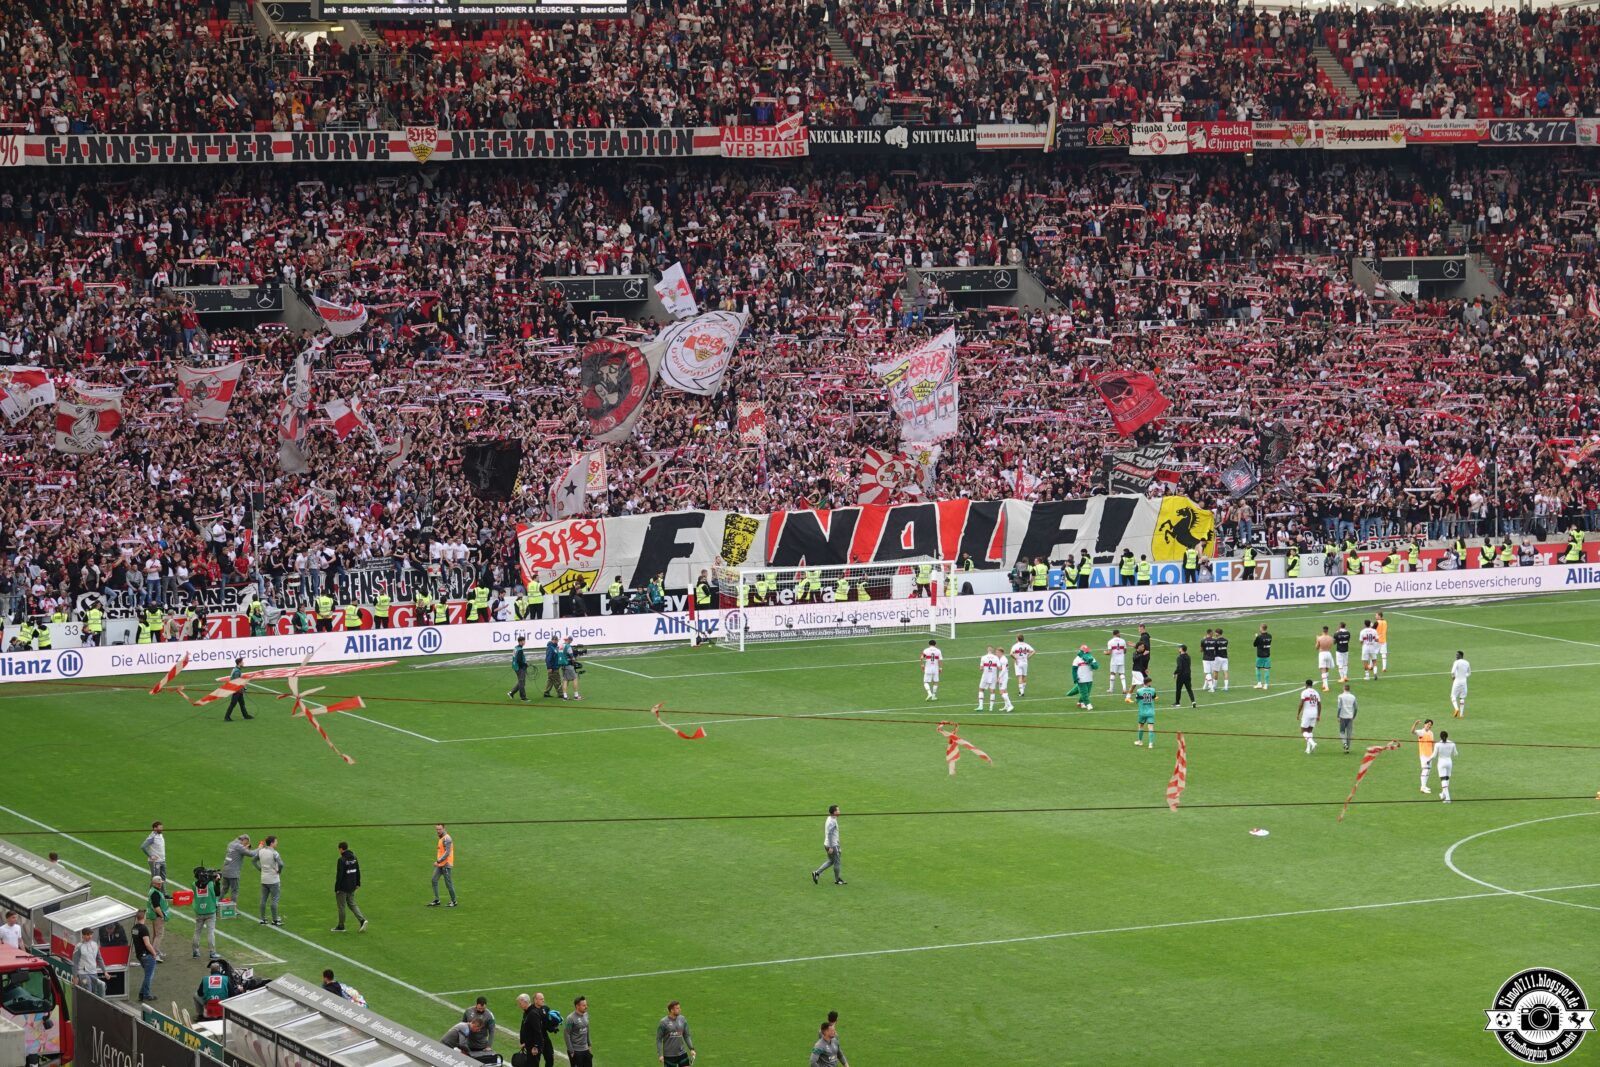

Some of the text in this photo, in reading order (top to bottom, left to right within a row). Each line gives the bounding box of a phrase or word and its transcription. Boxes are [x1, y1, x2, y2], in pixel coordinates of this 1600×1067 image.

[342, 6, 433, 16] Baden-Württembergische
[434, 6, 453, 14] Bank
[459, 6, 493, 14] Bankhaus
[495, 6, 527, 14] DONNER
[528, 6, 535, 14] &
[536, 6, 575, 14] REUSCHEL
[581, 6, 607, 14] Baresel
[809, 129, 881, 144] NECKAR-FILS
[912, 128, 976, 144] STUTTGART
[1131, 122, 1187, 134] Brigada Loca
[1210, 124, 1250, 136] Suebia
[1336, 125, 1389, 144] Hessen
[1546, 121, 1569, 142] 77
[45, 133, 389, 164] CANNSTATTER KURVE
[451, 128, 694, 158] NECKARSTADION
[725, 141, 805, 156] VFB-FANS
[1208, 138, 1252, 151] Ehingen
[526, 518, 601, 572] VfB
[579, 560, 591, 569] 93
[1307, 556, 1319, 566] 36
[1374, 573, 1542, 593] Die Allianz Lebensversicherung
[1117, 590, 1220, 607] Da für dein Leben.
[1265, 583, 1326, 601] Allianz
[982, 597, 1044, 616] Allianz
[774, 613, 793, 626] Die
[797, 611, 838, 624] Allianz
[64, 625, 79, 636] 33
[493, 631, 511, 643] Da
[514, 628, 531, 642] für
[533, 627, 562, 641] dein
[344, 634, 413, 654] Allianz
[111, 655, 136, 668] Die
[139, 652, 183, 666] Allianz
